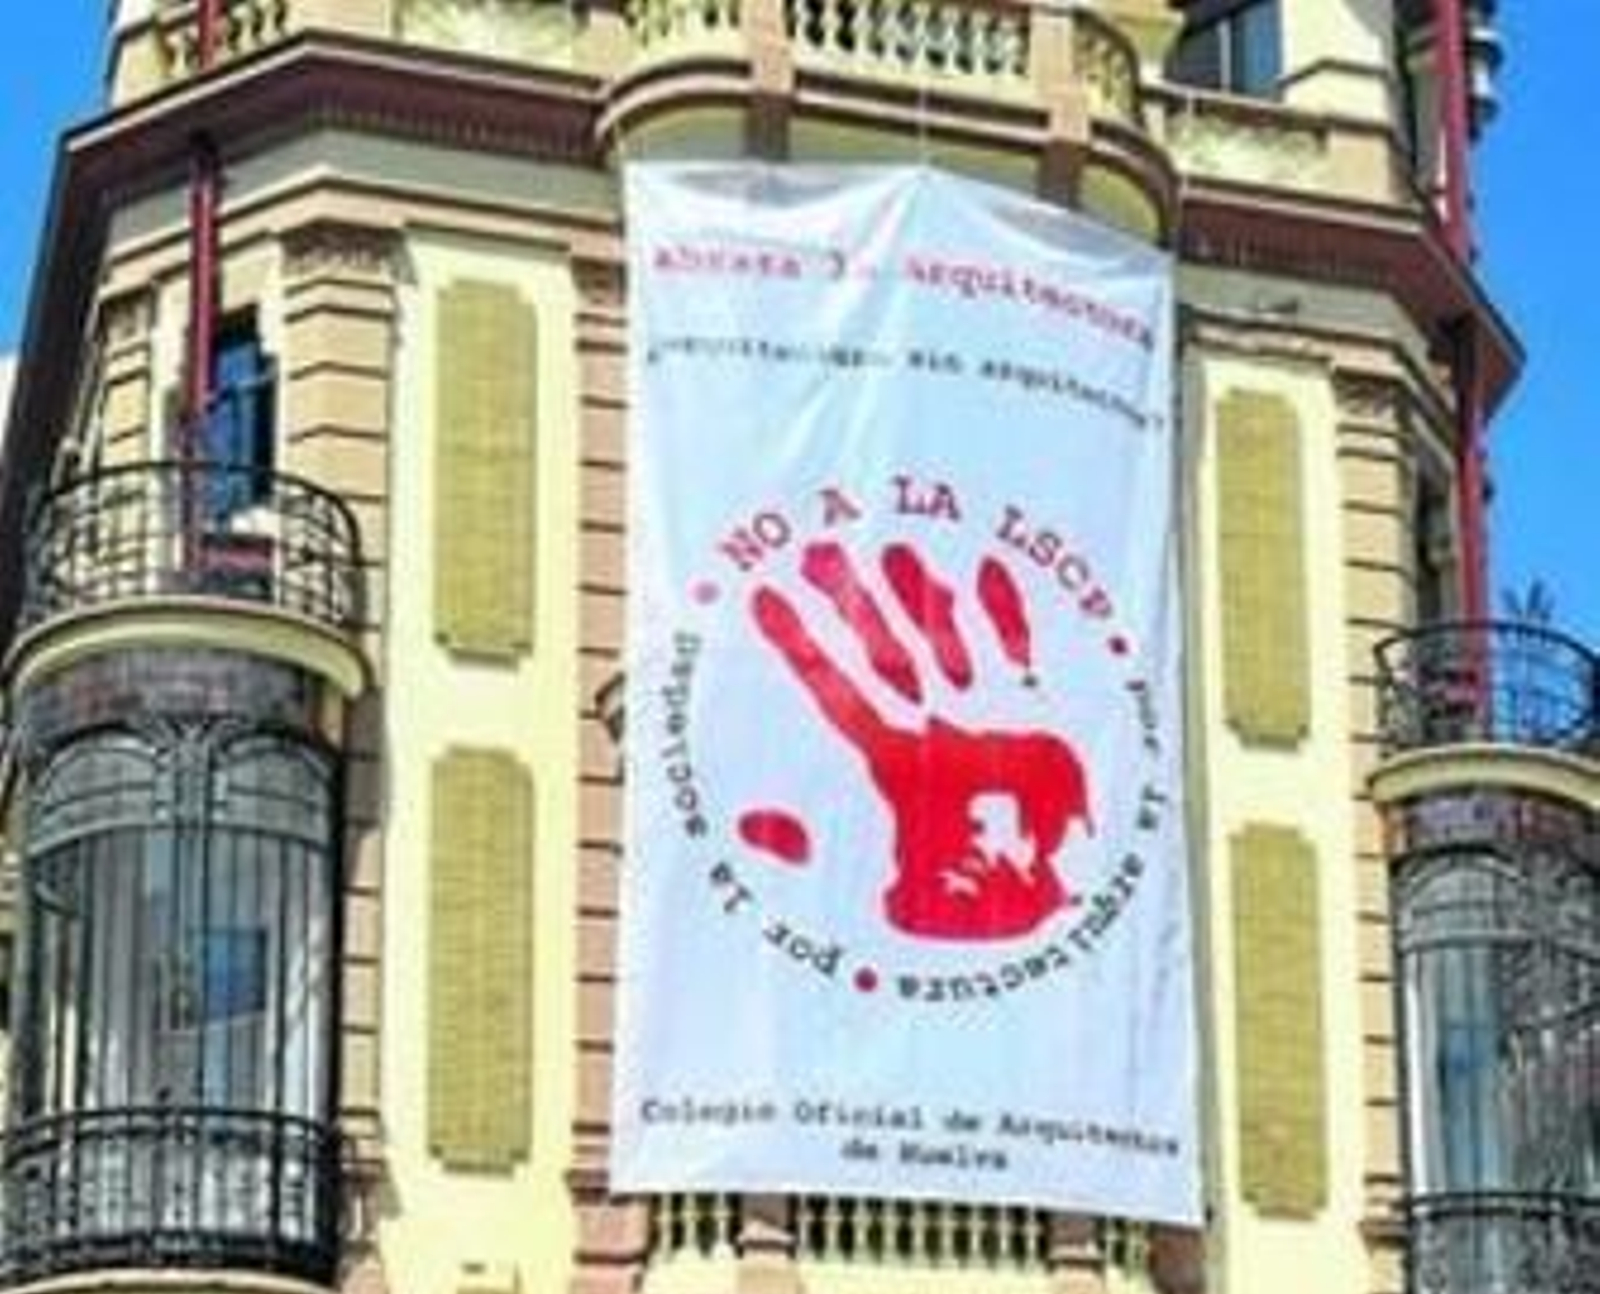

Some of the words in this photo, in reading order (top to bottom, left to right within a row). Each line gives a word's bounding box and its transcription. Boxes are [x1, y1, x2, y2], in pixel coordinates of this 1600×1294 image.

[718, 511, 792, 572] NO
[819, 486, 862, 528] A
[892, 475, 961, 522] LA
[996, 503, 1114, 619] LSCP
[709, 860, 754, 914] la
[762, 922, 847, 980] por
[898, 852, 1144, 1002] arquitectura
[640, 1098, 779, 1127] Colegio
[794, 1101, 923, 1131] Oficial
[943, 1109, 981, 1131] de
[841, 1137, 879, 1160] de
